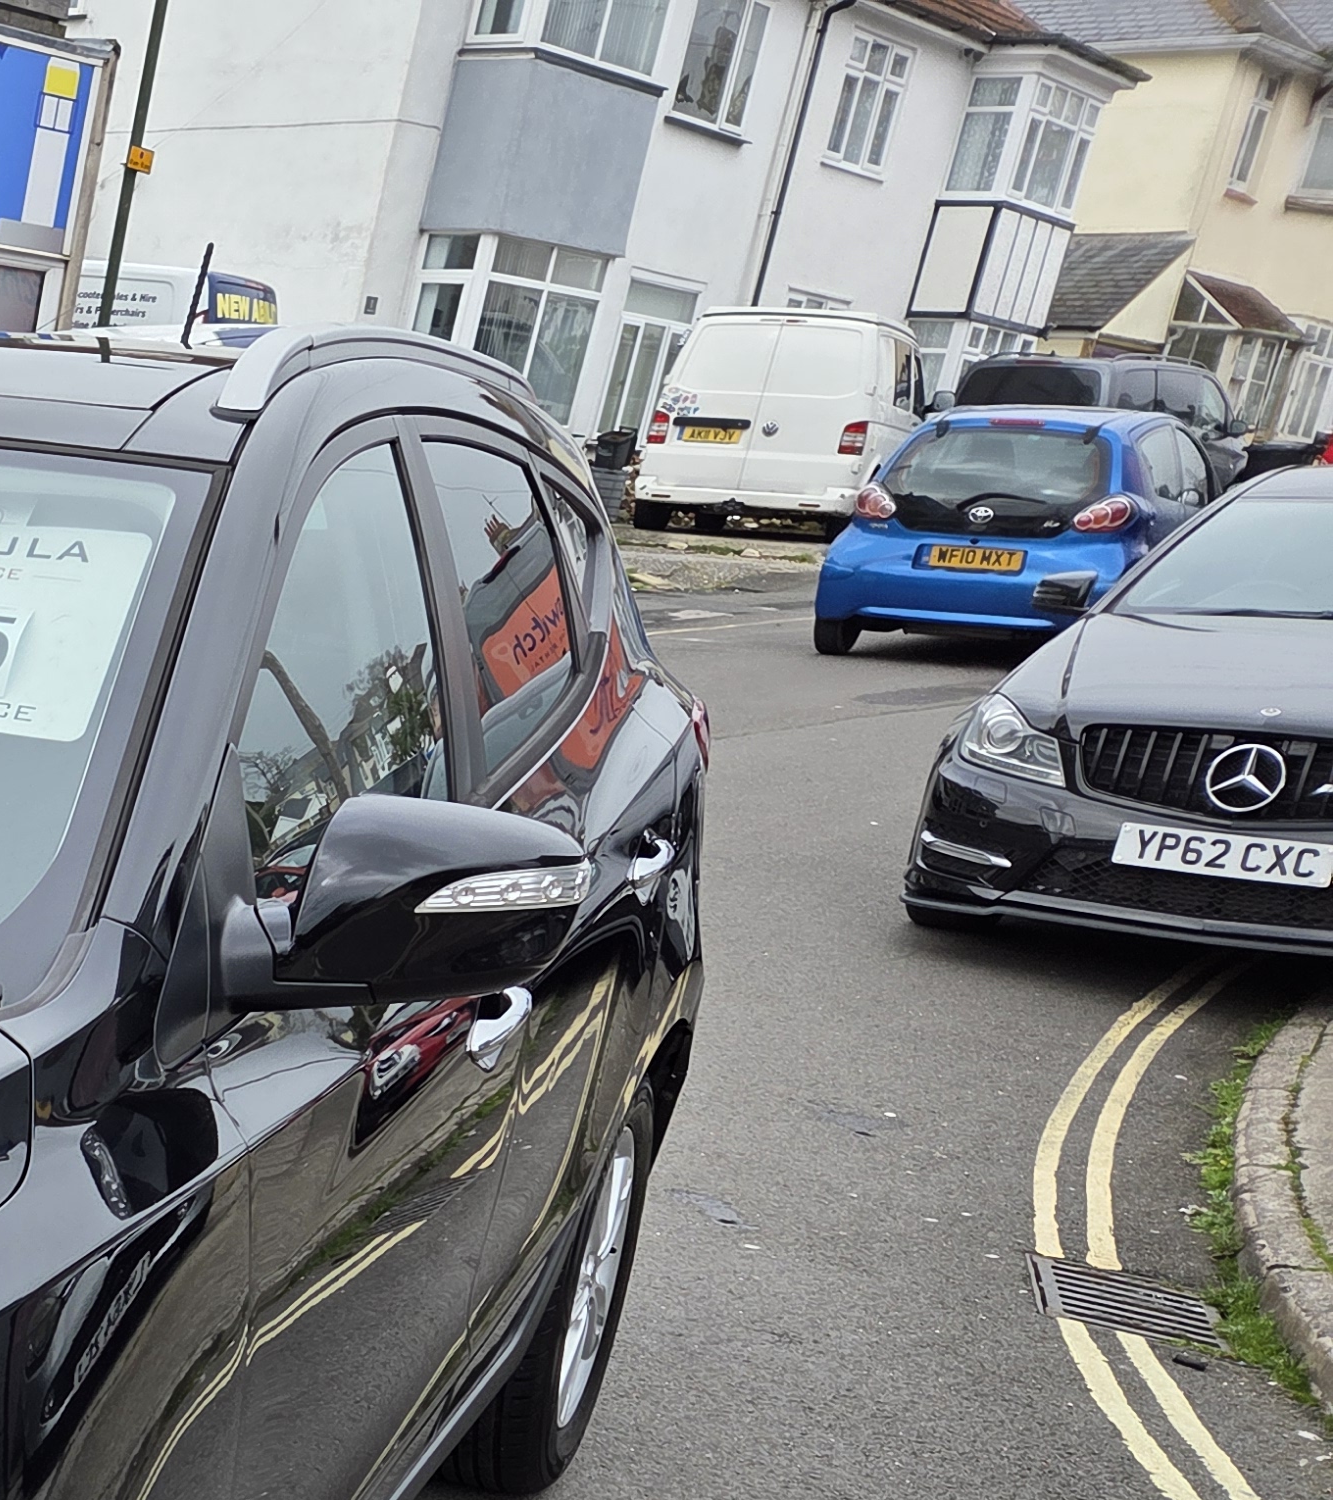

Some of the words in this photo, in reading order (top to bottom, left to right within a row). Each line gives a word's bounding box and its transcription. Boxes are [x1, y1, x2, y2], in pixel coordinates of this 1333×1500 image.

[216, 292, 250, 322] NEW
[1136, 828, 1233, 870] YP62
[1239, 842, 1322, 879] CXC
